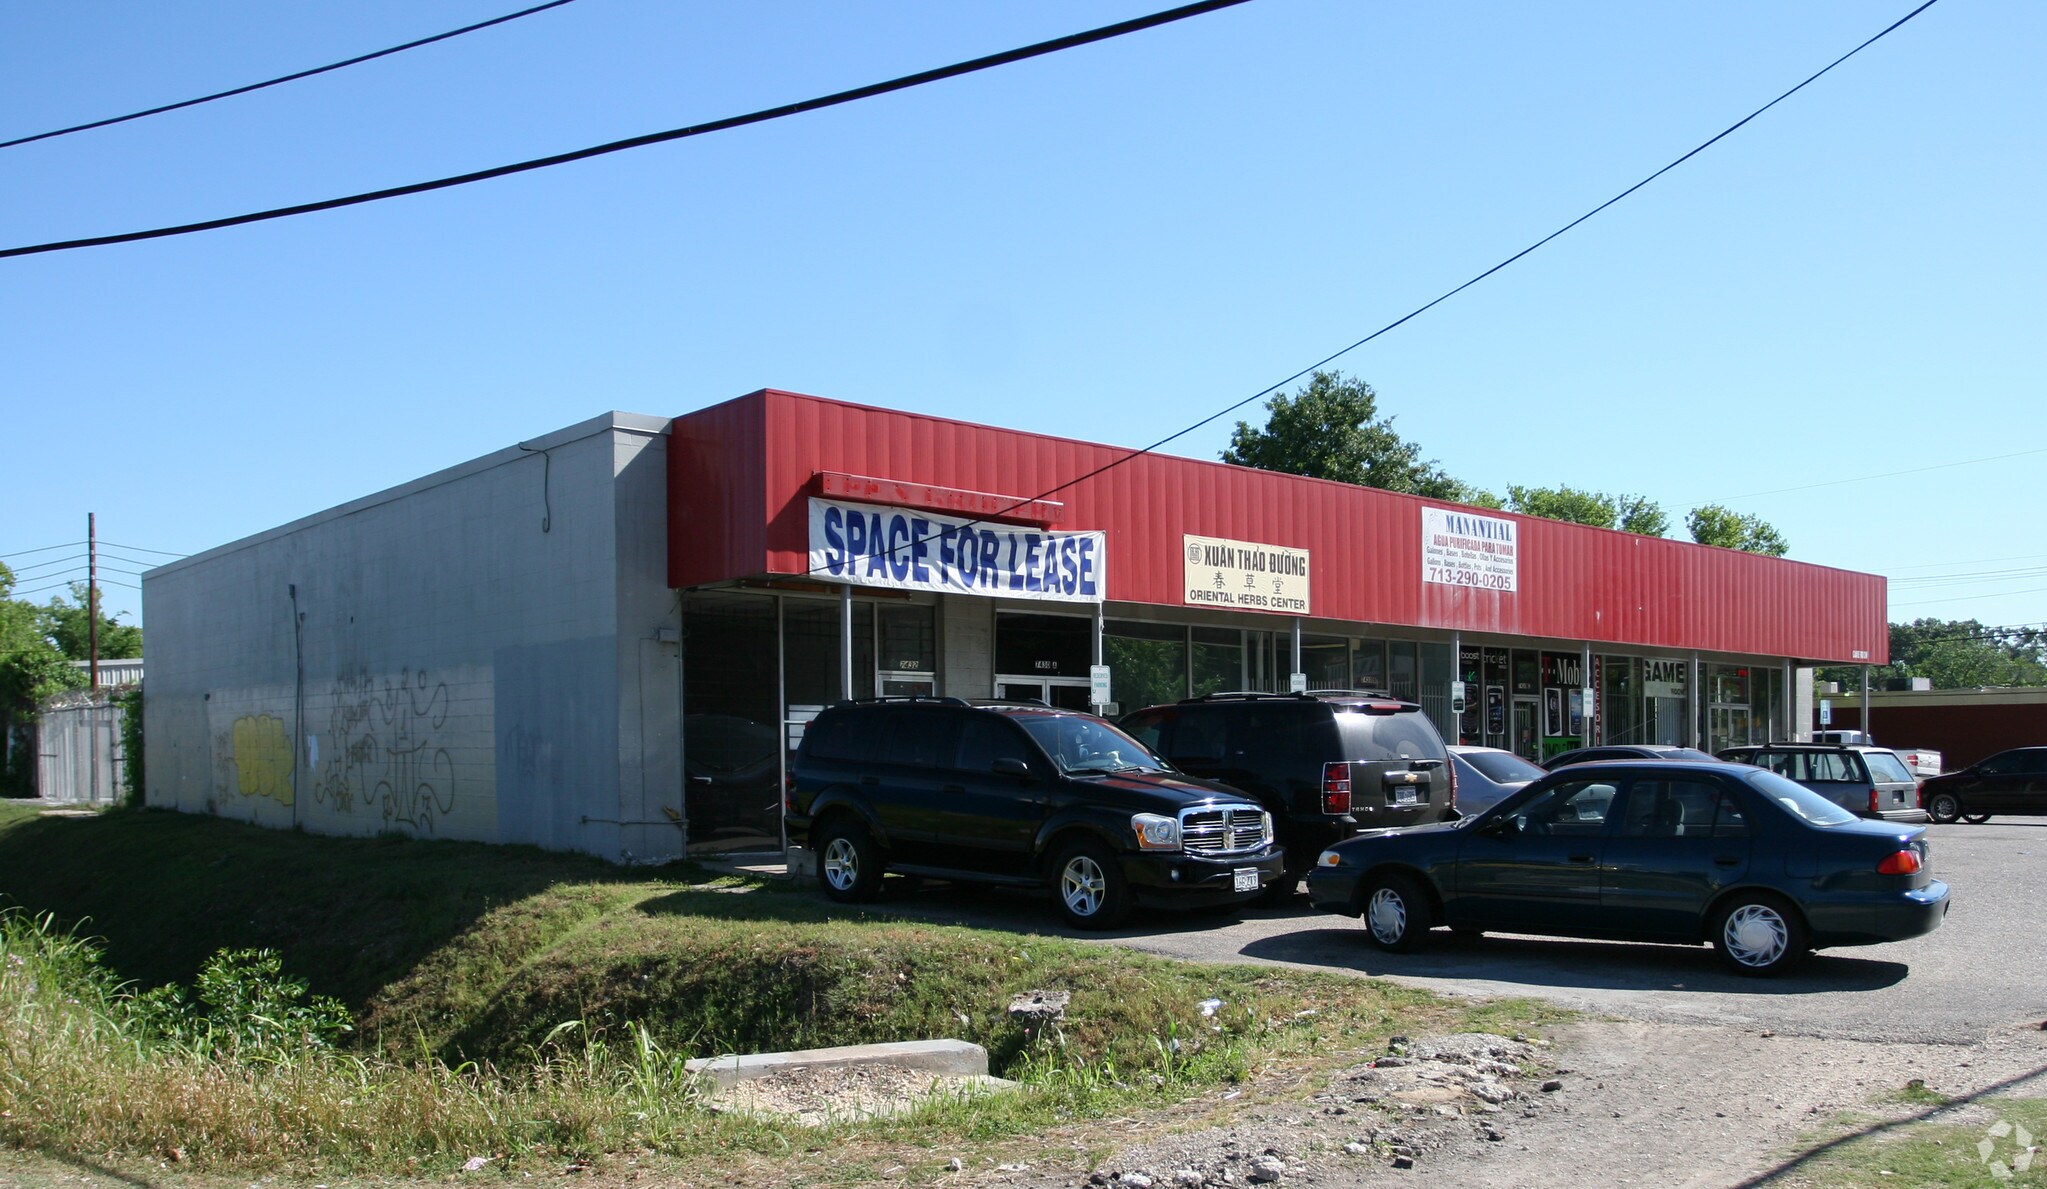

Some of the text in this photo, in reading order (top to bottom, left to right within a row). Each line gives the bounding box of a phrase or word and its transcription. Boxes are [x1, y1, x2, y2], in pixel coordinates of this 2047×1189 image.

[1445, 515, 1512, 541] MANANTIAL
[824, 507, 1097, 596] SPACE FOR LEASE
[1434, 534, 1448, 547] AGUA
[1482, 541, 1495, 553] PARA
[1204, 545, 1235, 568] XUÂN
[1429, 567, 1511, 590] 713-290-0205
[1189, 589, 1306, 610] ORIENTAL HERBS CENTER
[1460, 651, 1480, 660] boost
[1644, 660, 1685, 684] GAME
